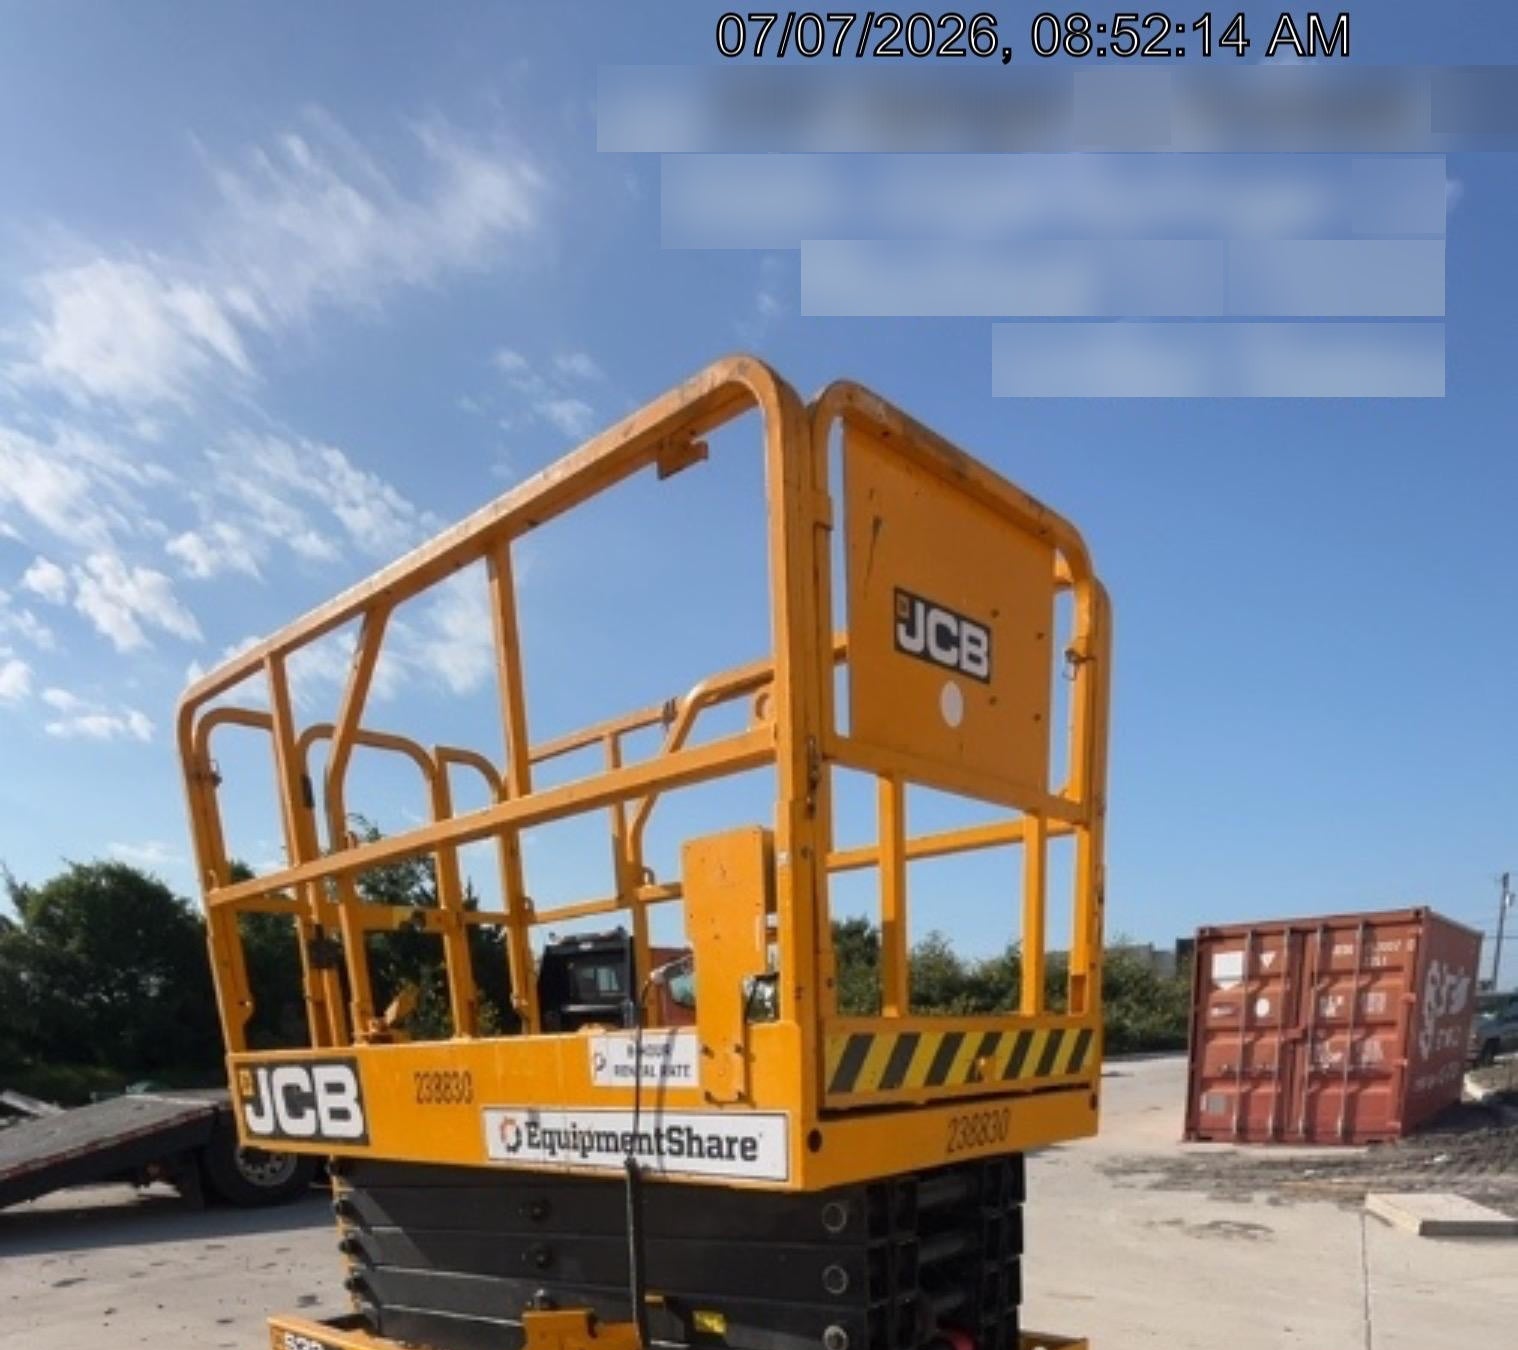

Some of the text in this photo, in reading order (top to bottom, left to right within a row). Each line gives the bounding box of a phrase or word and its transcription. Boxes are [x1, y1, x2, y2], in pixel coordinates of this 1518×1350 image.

[896, 600, 990, 679] JCB
[245, 1063, 365, 1139] JCB
[524, 1120, 758, 1162] EquipmentShare
